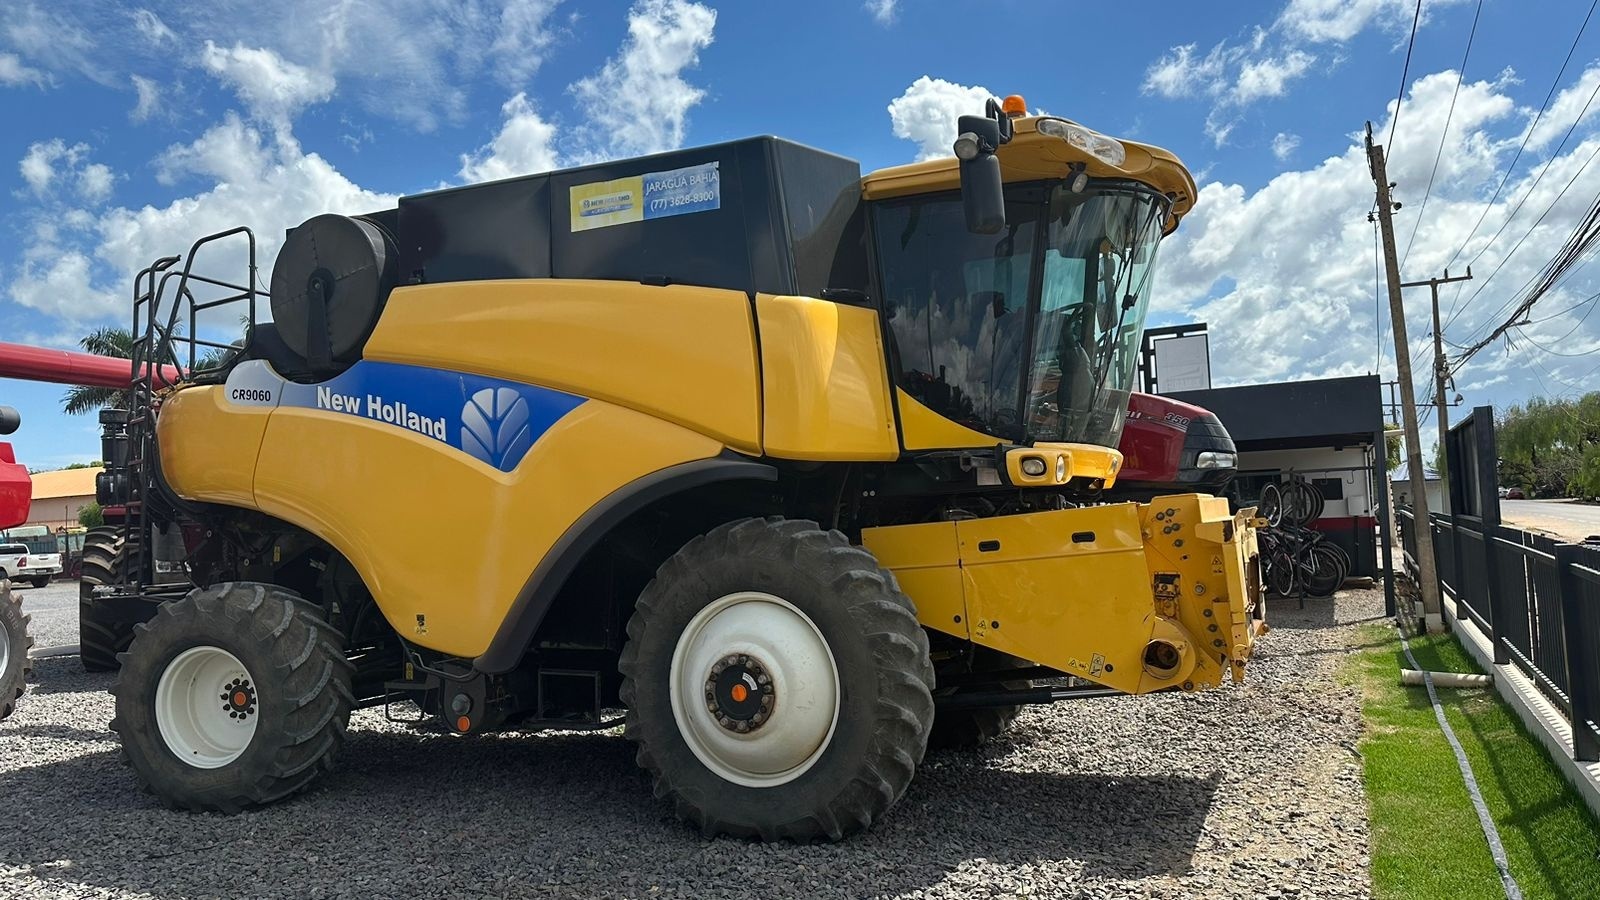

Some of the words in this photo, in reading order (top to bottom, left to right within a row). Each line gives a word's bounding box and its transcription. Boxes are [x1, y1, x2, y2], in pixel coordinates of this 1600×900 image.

[690, 171, 718, 185] BAHIA
[650, 199, 667, 212] (77)
[669, 191, 714, 206] 3628-8300
[232, 389, 271, 402] CR9060
[317, 386, 361, 414] New
[367, 394, 447, 441] Holland
[1164, 412, 1191, 426] 350
